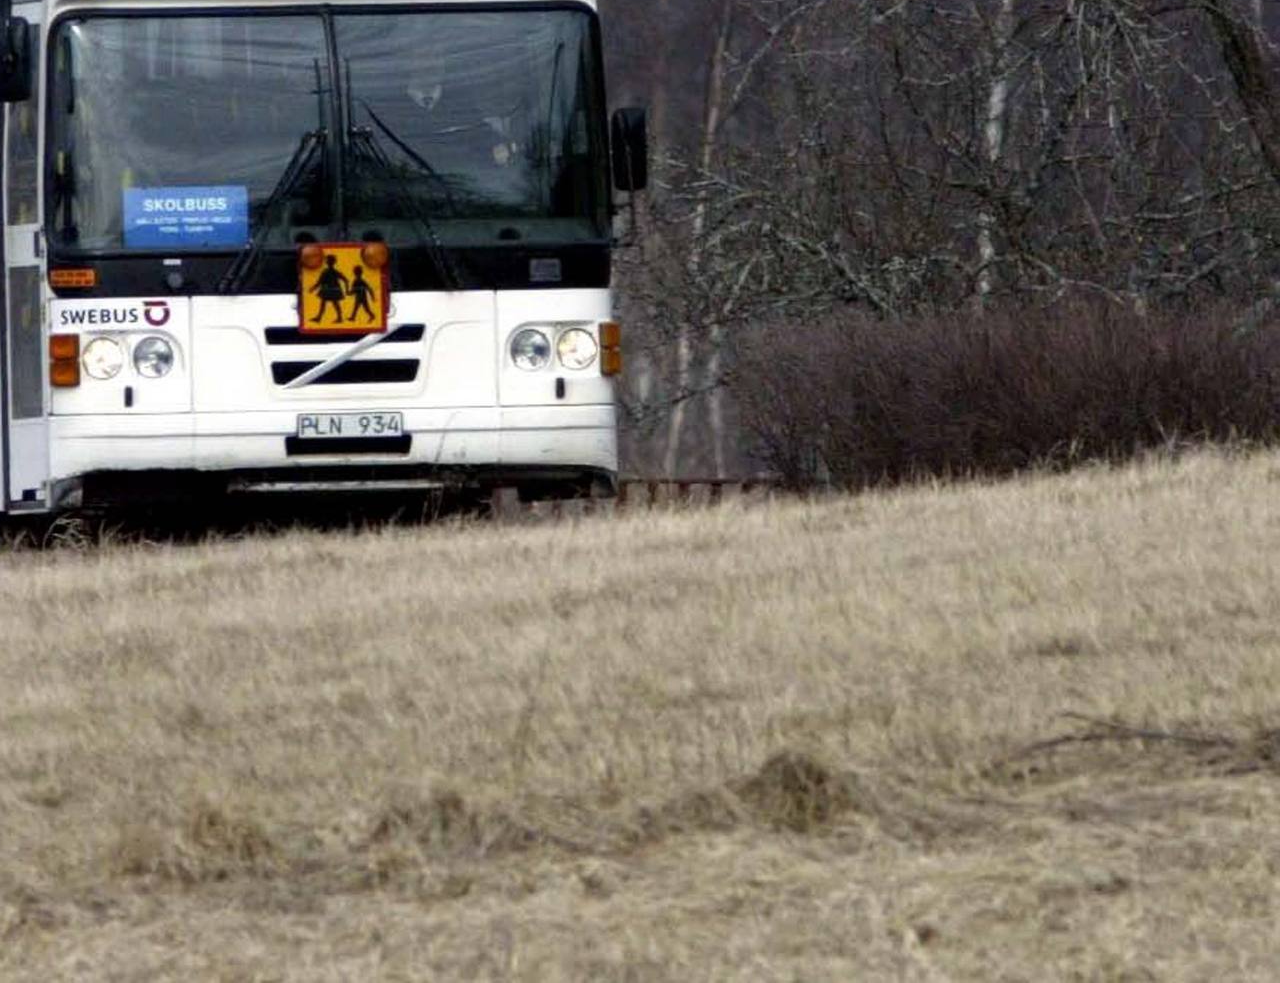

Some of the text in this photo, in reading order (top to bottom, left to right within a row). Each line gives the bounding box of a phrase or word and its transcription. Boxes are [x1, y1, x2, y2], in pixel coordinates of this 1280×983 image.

[143, 197, 228, 212] SKOLBUSS
[60, 307, 139, 325] SWEBUS
[301, 415, 400, 435] PLN 934
